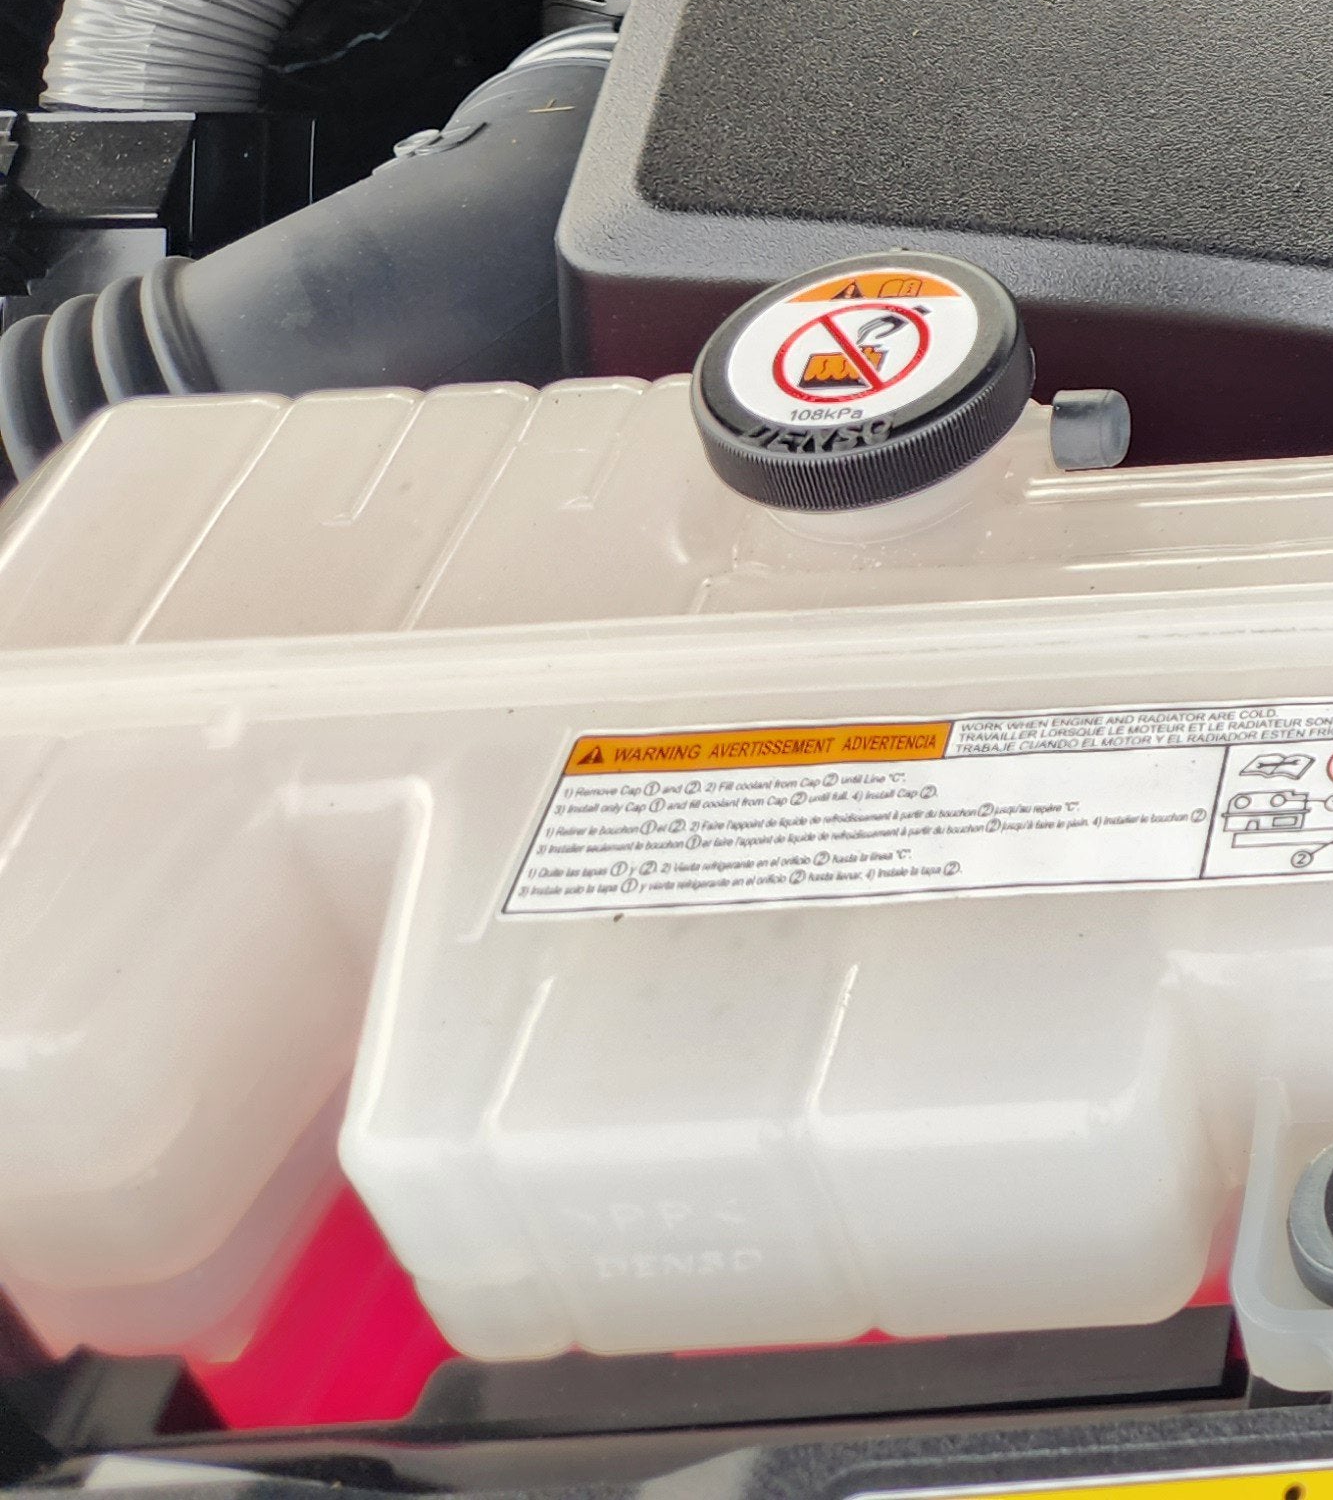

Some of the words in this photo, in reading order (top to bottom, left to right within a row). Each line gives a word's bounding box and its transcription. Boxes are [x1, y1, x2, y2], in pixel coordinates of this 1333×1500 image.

[790, 407, 865, 422] 108kPa
[748, 410, 893, 454] DENSO
[958, 729, 1038, 742] TRAVAILLER
[1040, 726, 1105, 738] LORSQUE
[1106, 725, 1124, 735] LE
[1127, 723, 1184, 734] MOTEUR
[1188, 722, 1204, 732] ET
[1207, 722, 1224, 731] LE
[1227, 717, 1302, 730] RADIATEUR
[960, 722, 1003, 731] WORK
[1006, 720, 1048, 729] WHEN
[1051, 716, 1102, 727] ENGINE
[1105, 714, 1134, 724] AND
[1137, 711, 1206, 723] RADIATOR
[1207, 711, 1236, 721] ARE
[1238, 708, 1278, 719] COLD.
[614, 744, 700, 762] WARNING
[710, 737, 834, 758] AVERTISSEMENT
[841, 732, 936, 752] ADVERTENCIA
[955, 741, 1016, 754] TRABAJE
[1018, 738, 1080, 750] CUANDO
[1080, 737, 1097, 748] EL
[1100, 735, 1151, 746] MOTOR
[1154, 734, 1164, 743] Y
[1166, 734, 1181, 744] EL
[1186, 731, 1258, 743] RADIADOR
[620, 784, 640, 797] Cap
[773, 778, 797, 789] from
[799, 776, 820, 788] Cap
[624, 801, 646, 813] Cap
[766, 794, 788, 807] Cap
[896, 787, 918, 799] Cap
